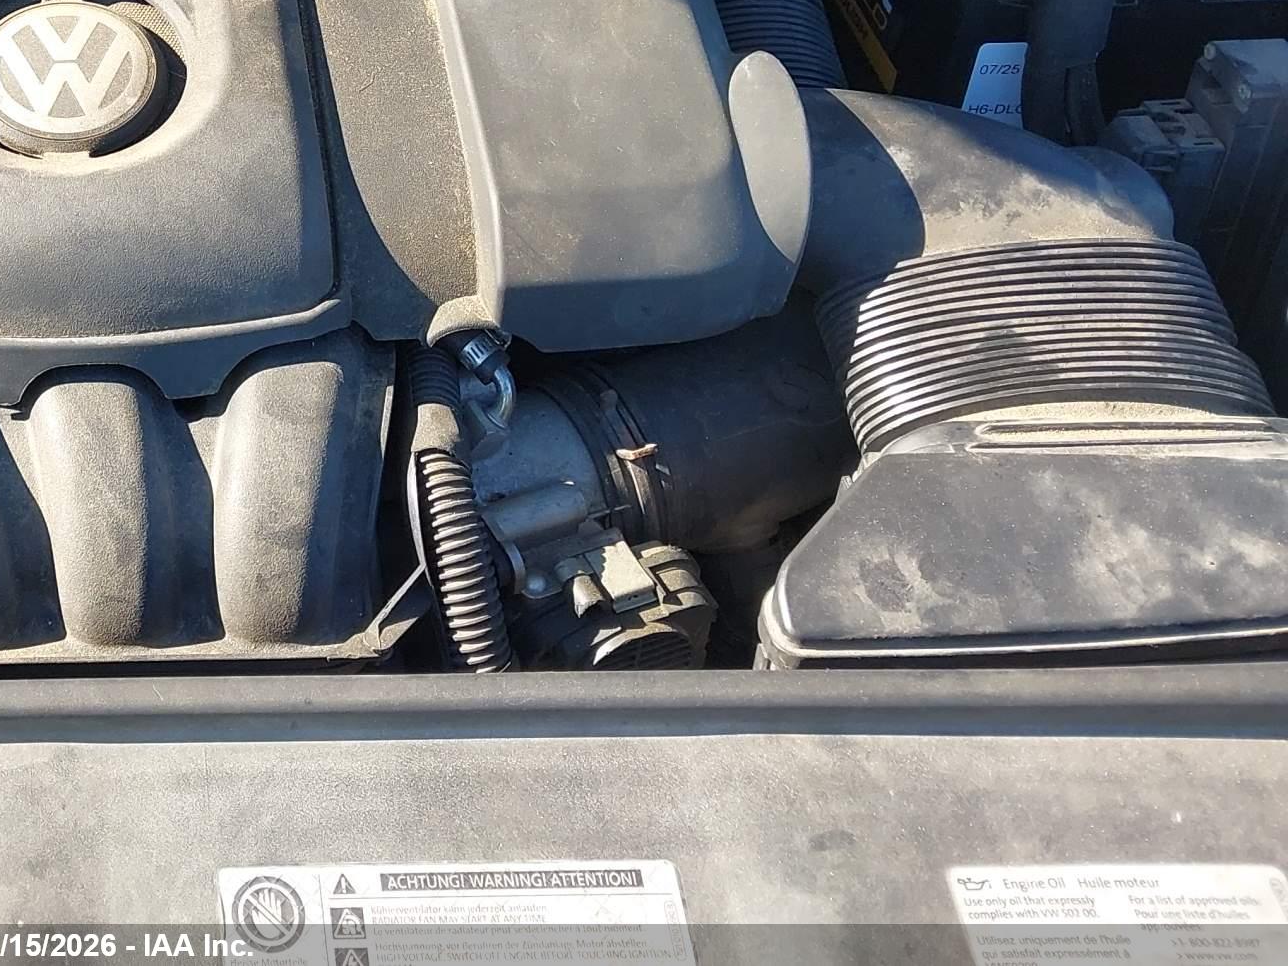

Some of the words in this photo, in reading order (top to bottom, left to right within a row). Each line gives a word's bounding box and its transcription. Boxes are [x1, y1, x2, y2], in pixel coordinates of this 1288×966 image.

[979, 64, 1021, 75] 07/25
[387, 875, 465, 891] ACHTUNG!
[469, 873, 546, 890] WARNING!
[552, 872, 638, 887] ATTENTION!
[1002, 878, 1046, 892] Engine
[1047, 877, 1066, 889] Oil
[1077, 877, 1112, 888] Huile
[1114, 878, 1160, 889] moteur
[964, 897, 983, 906] Use
[986, 897, 1007, 908] only
[1009, 896, 1023, 906] oil
[1024, 896, 1047, 905] that
[1048, 895, 1095, 908] expressly
[1128, 895, 1144, 905] For
[1157, 895, 1173, 905] list
[1175, 895, 1185, 905] of
[1189, 896, 1237, 907] approved
[968, 909, 1013, 921] complies
[1016, 909, 1039, 919] with
[1040, 909, 1059, 919] VW
[1018, 935, 1081, 948] uniquement
[1083, 935, 1098, 945] de
